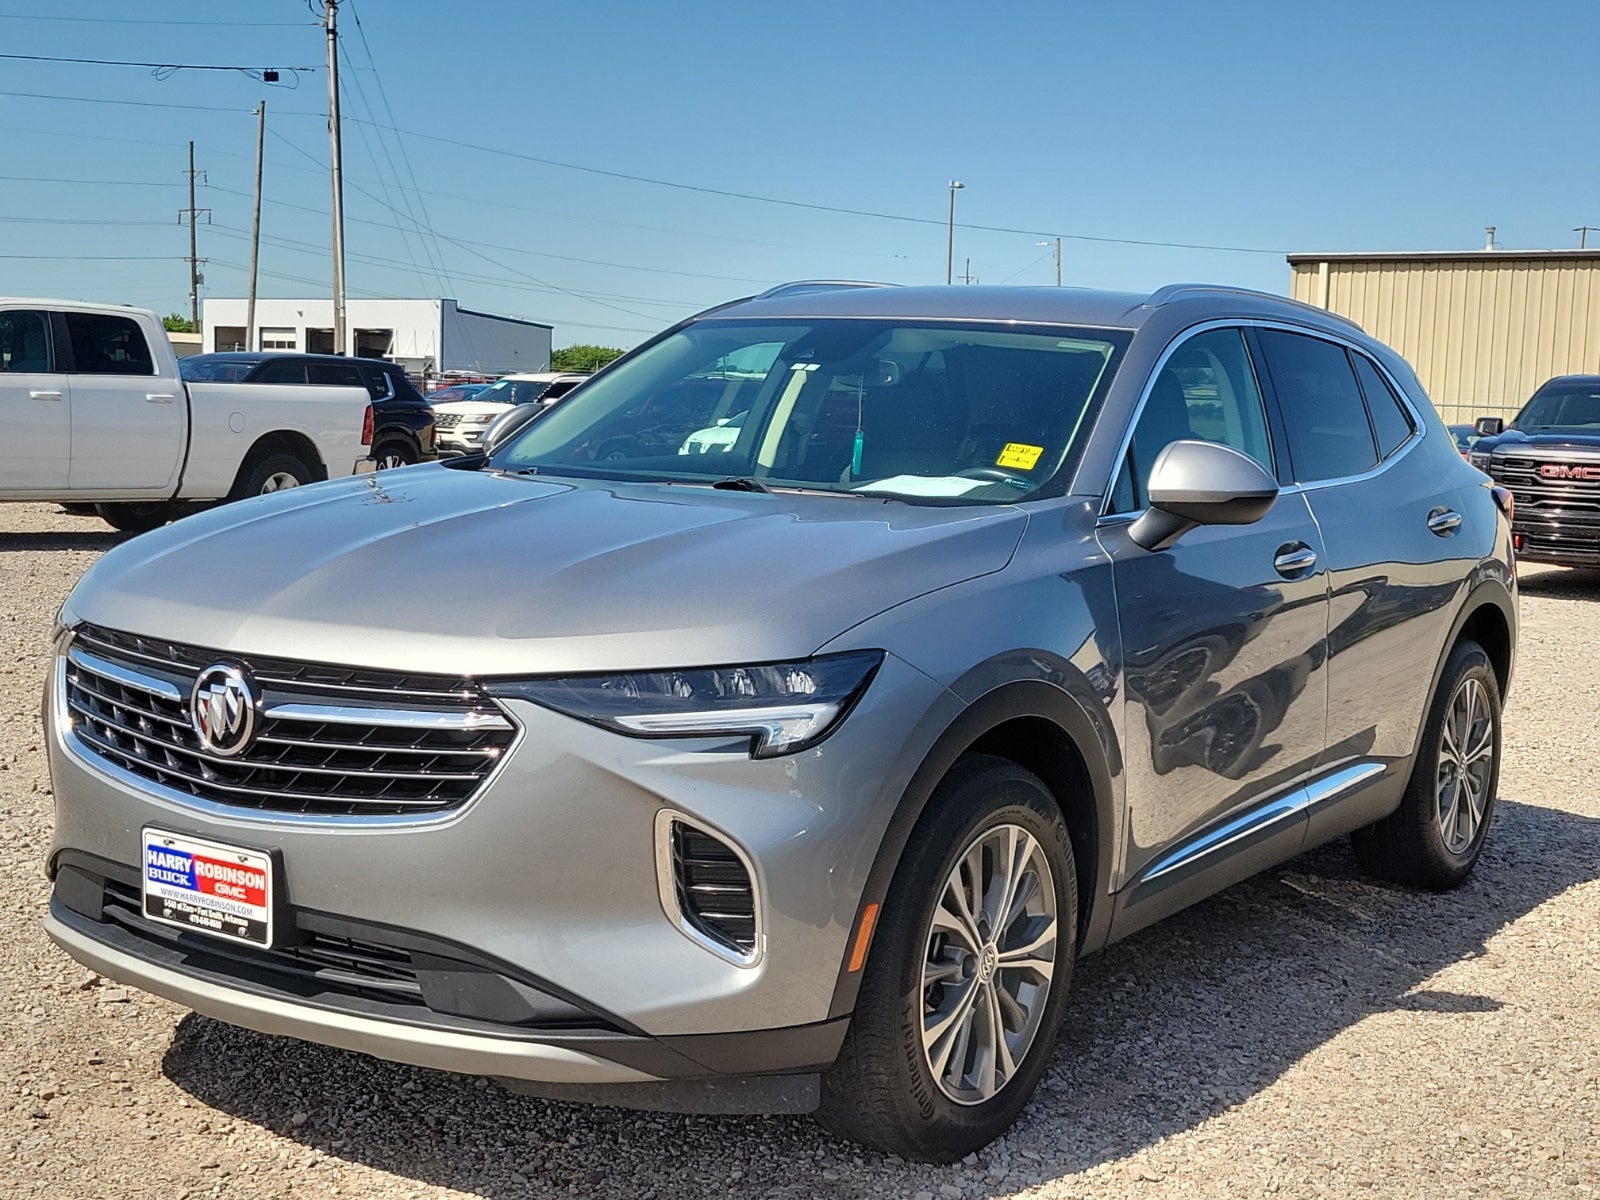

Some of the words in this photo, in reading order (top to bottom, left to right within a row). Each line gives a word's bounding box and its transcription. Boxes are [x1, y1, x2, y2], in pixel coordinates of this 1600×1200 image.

[1540, 465, 1600, 480] GMC
[147, 850, 193, 873] HARRY
[195, 860, 266, 890] ROBINSON
[148, 867, 191, 886] BUICK
[214, 882, 247, 899] GMC
[160, 887, 253, 916] WWW.HARRYROBINSON.COM
